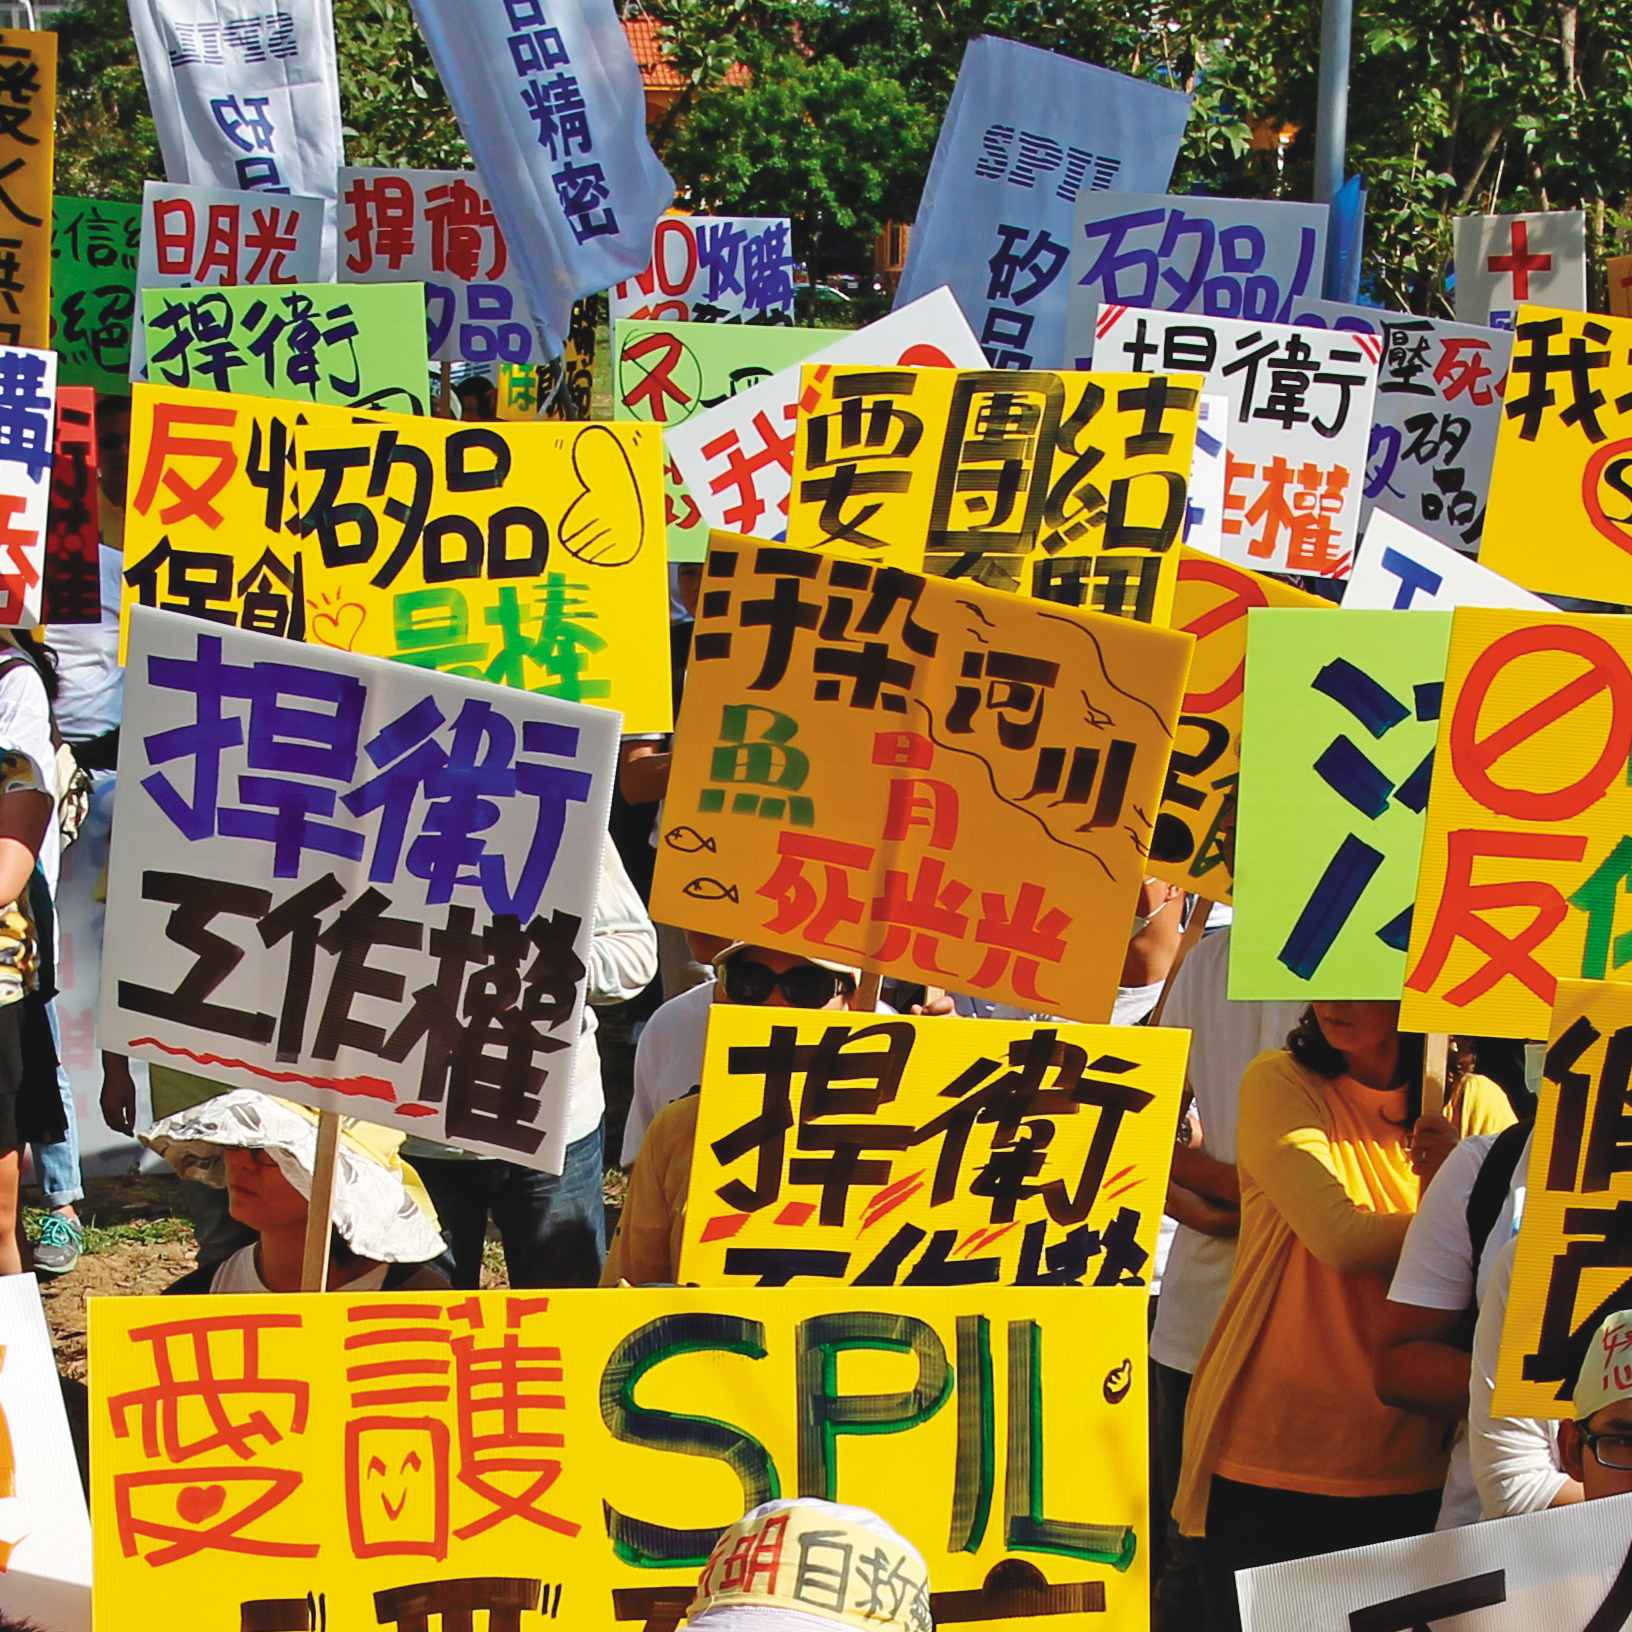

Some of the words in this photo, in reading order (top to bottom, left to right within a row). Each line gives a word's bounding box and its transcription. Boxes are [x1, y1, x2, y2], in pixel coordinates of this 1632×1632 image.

[506, 0, 620, 246] 品精密
[153, 198, 301, 288] 日月光
[344, 176, 509, 281] 捍衛
[146, 291, 361, 397] 捍衛
[1378, 319, 1508, 406] 壓死
[302, 427, 551, 590] 矽品
[798, 370, 1199, 554] 要團結
[140, 633, 592, 925] 捍衛
[756, 829, 1074, 1006] 死光光
[117, 870, 584, 1155] 工作權
[711, 1021, 1156, 1226] 捍衛
